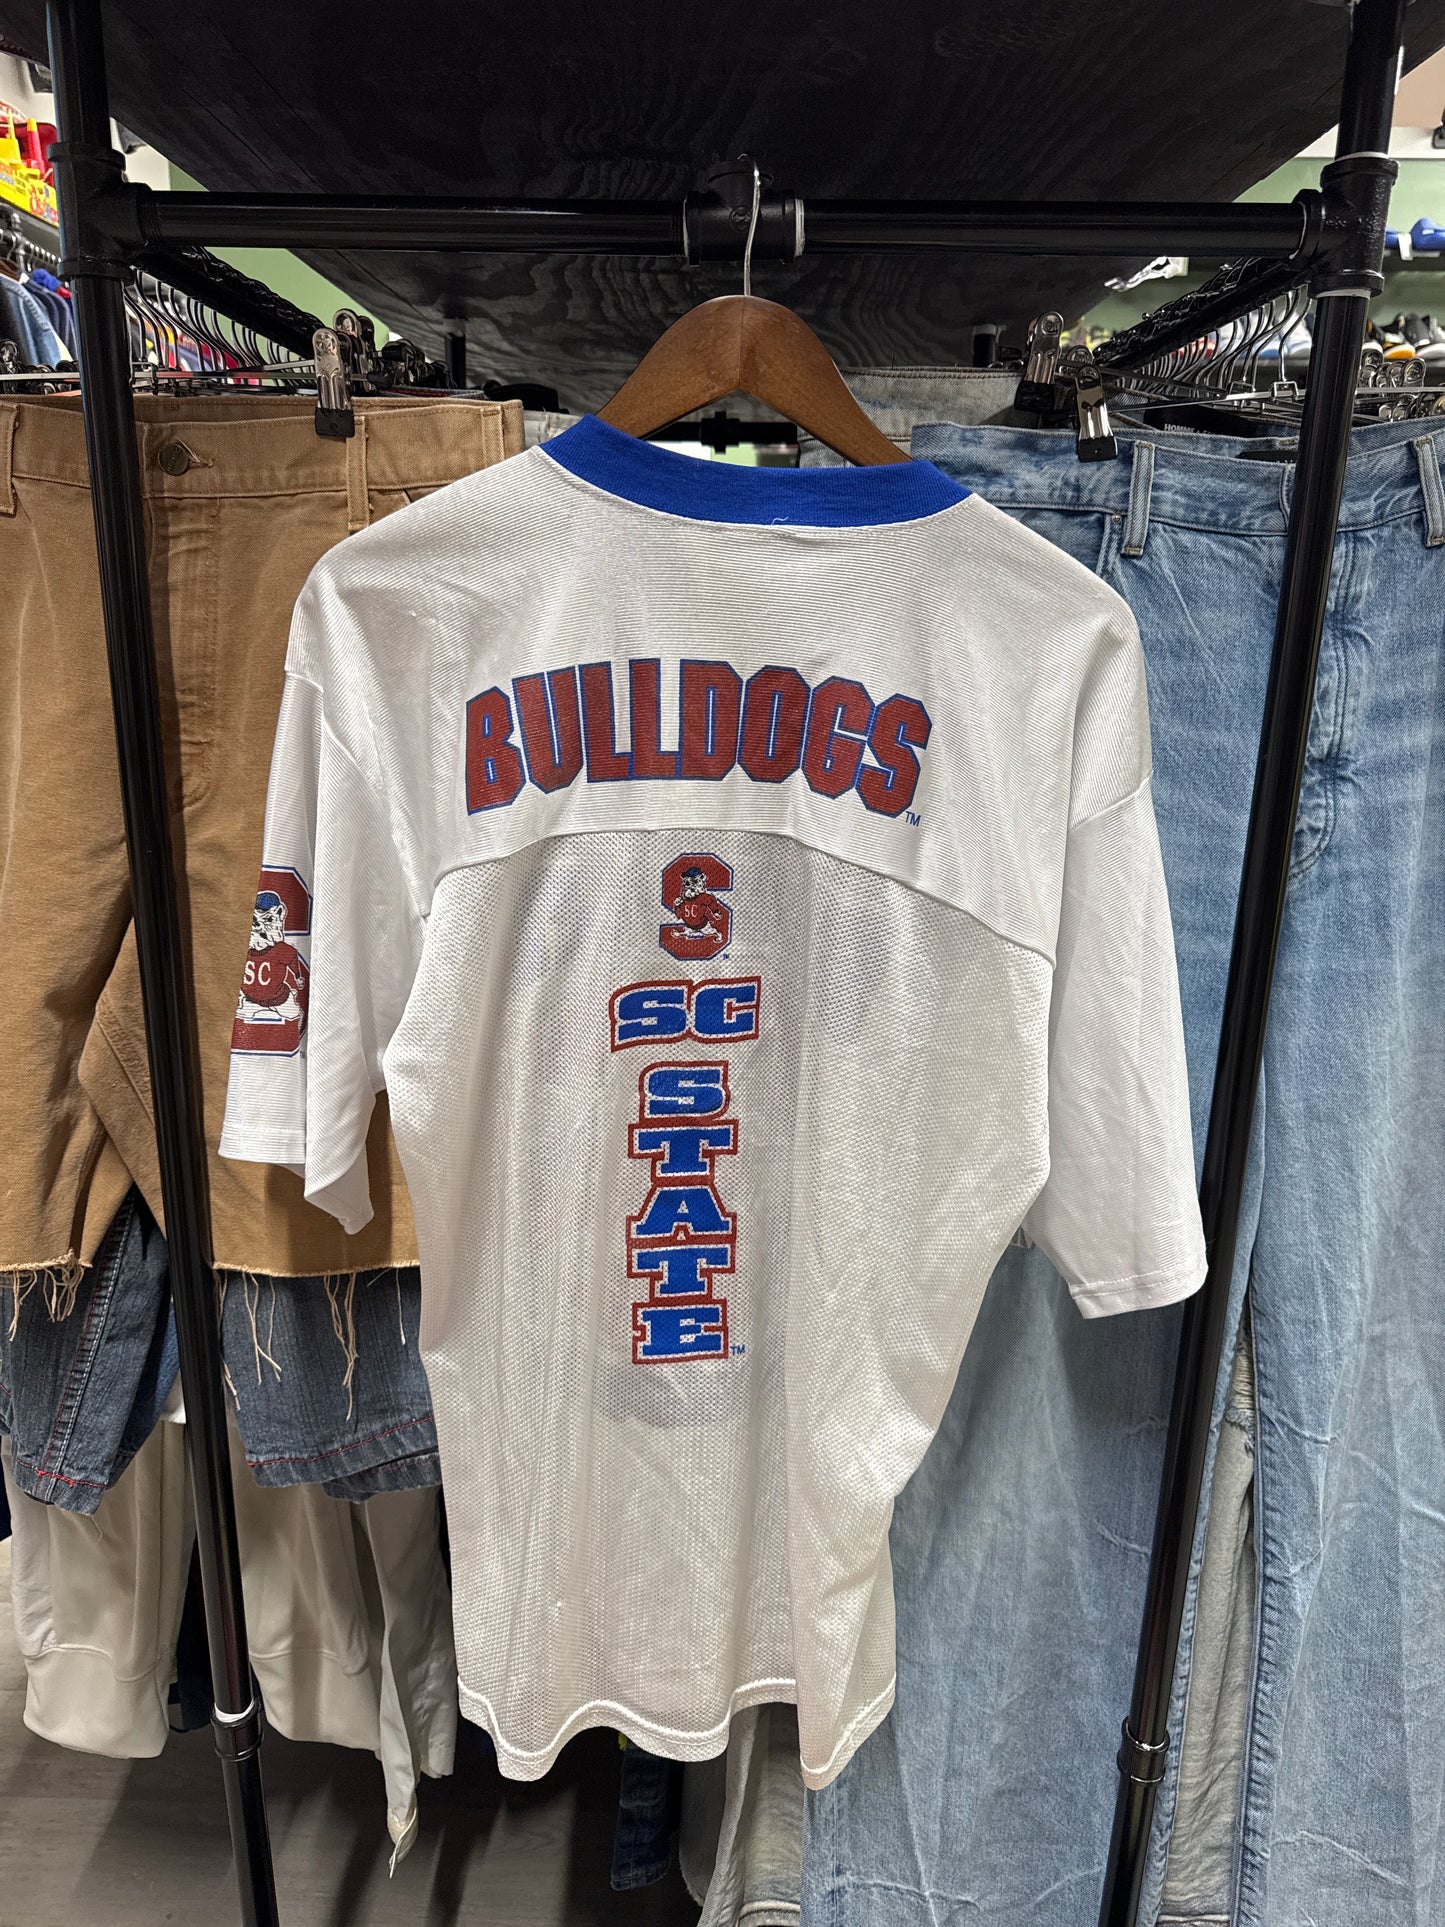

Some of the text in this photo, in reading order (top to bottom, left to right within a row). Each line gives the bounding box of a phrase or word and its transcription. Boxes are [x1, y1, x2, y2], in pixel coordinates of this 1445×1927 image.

[466, 657, 933, 827] BULLDOGS TM
[684, 904, 698, 918] SC
[243, 960, 272, 986] SC
[608, 976, 762, 1053] SC
[625, 1060, 746, 1364] STATE TM
